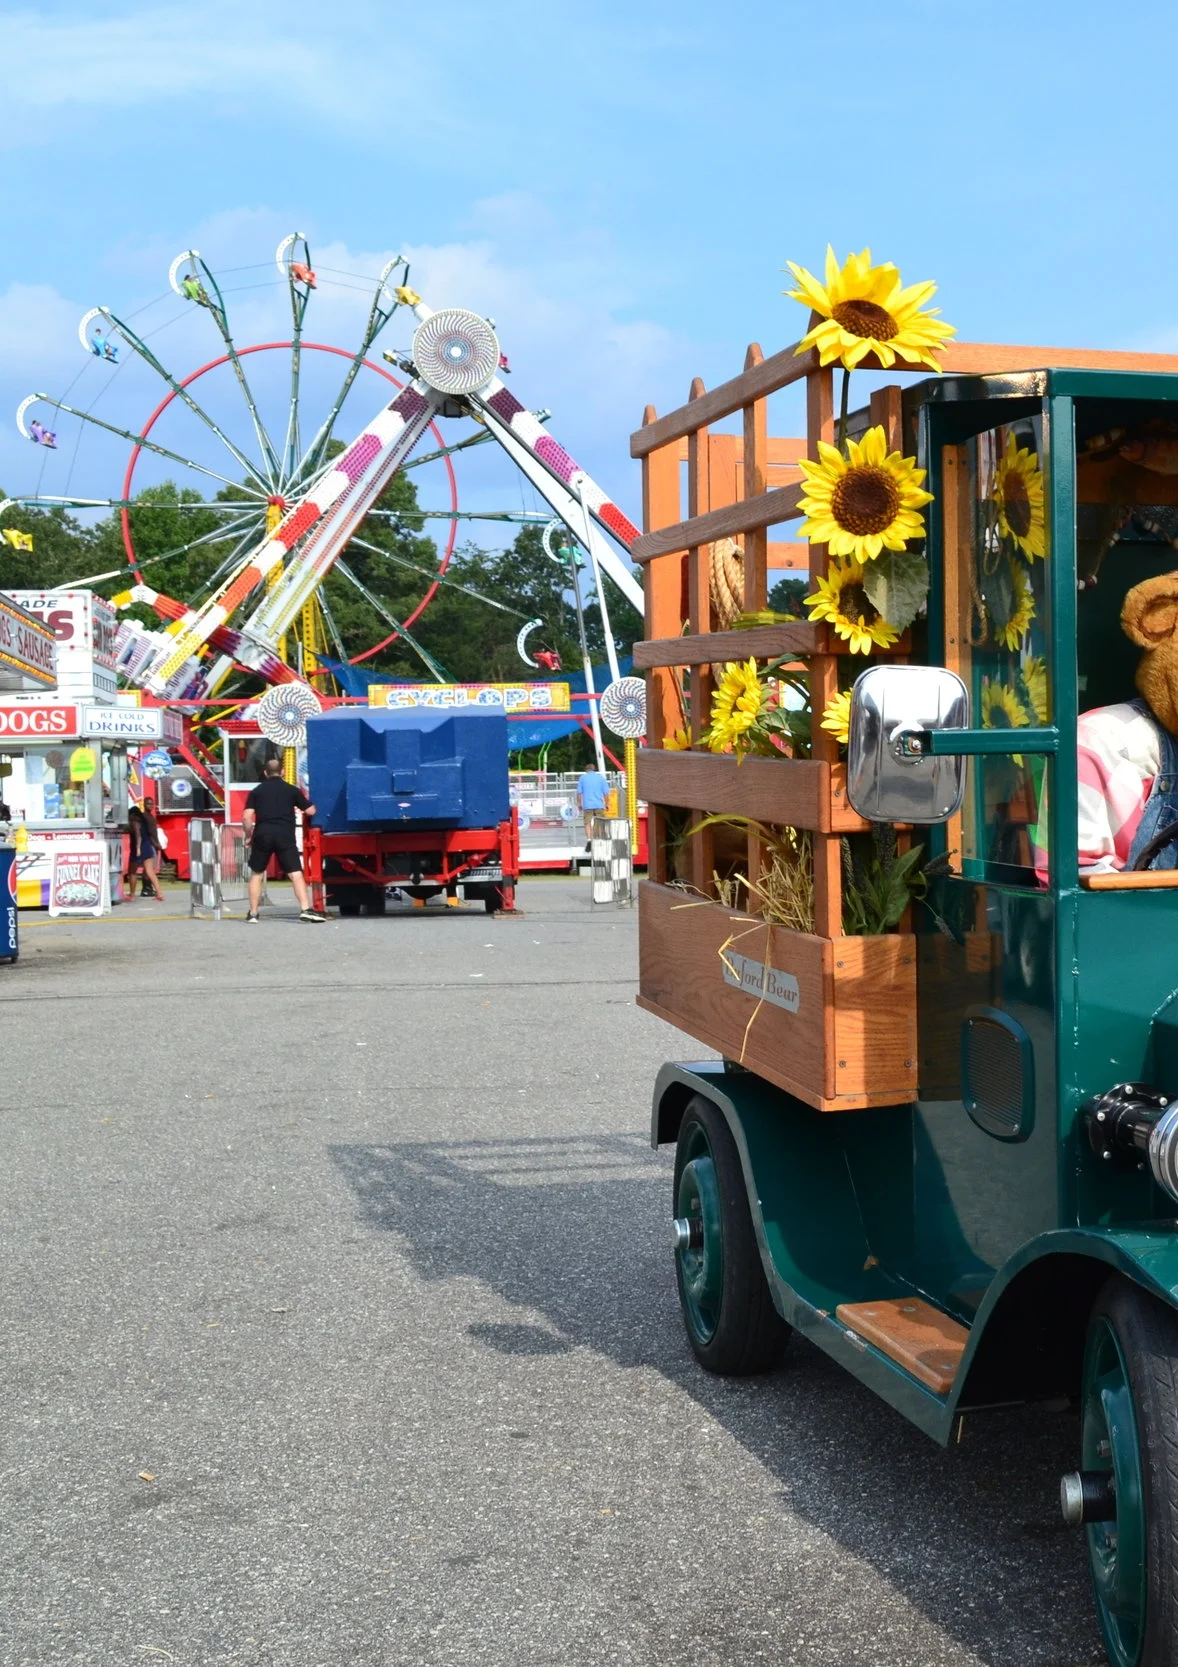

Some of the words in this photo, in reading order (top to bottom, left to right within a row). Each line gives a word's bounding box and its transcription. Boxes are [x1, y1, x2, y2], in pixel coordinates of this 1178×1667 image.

[387, 688, 552, 709] CYCLOPS
[89, 721, 156, 733] DRINKS
[8, 906, 17, 949] pepsi
[766, 972, 798, 1003] Bear
